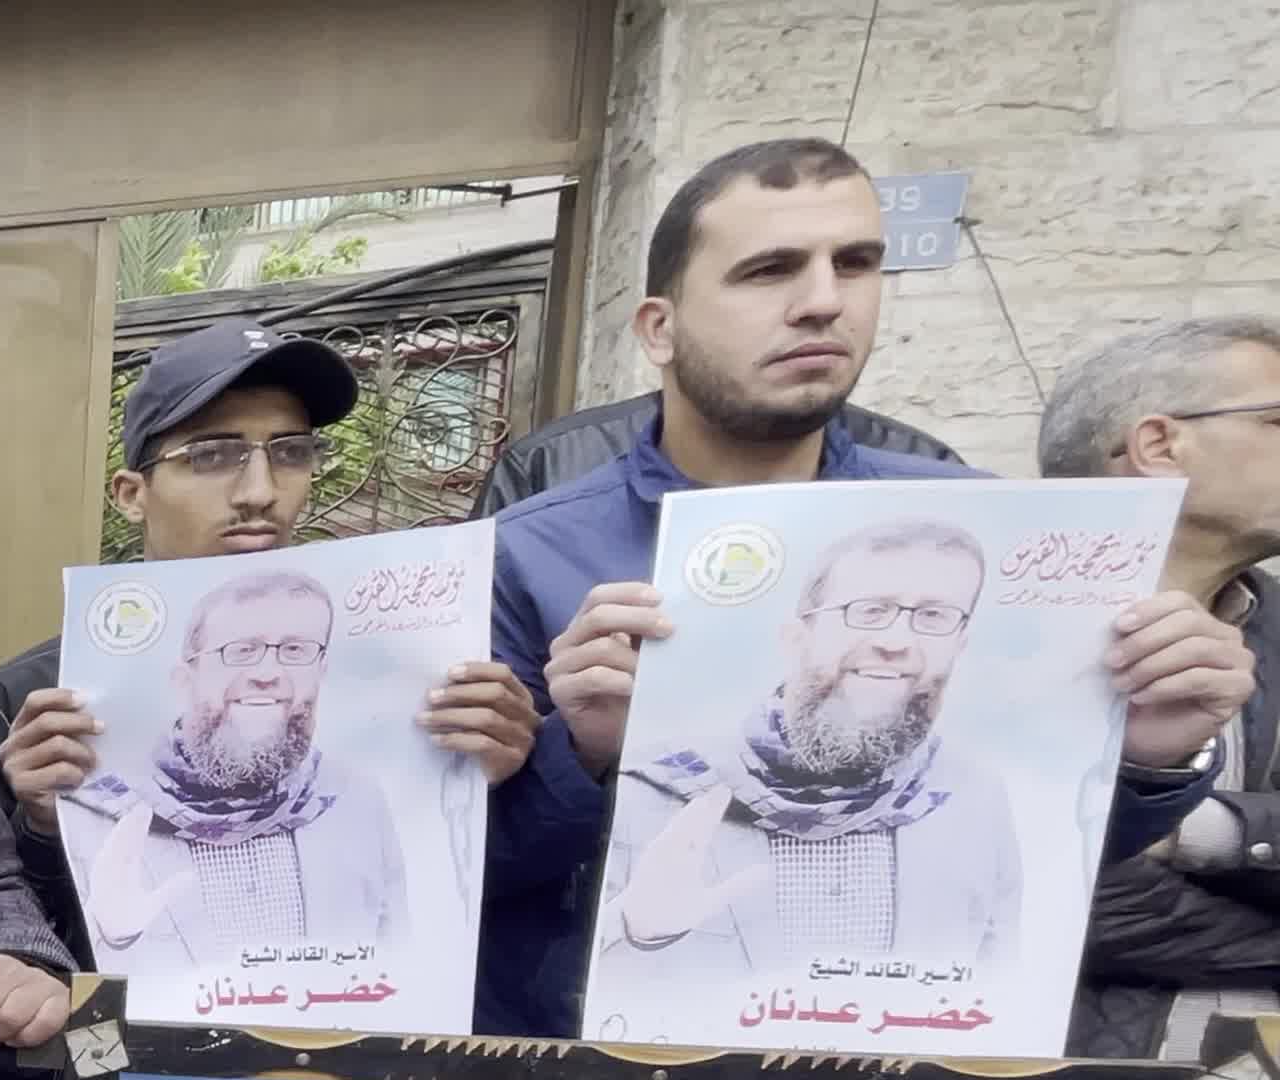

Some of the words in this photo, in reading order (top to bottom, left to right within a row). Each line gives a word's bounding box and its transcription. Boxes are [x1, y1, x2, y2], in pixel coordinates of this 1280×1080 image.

[809, 957, 860, 980] الشيخ
[865, 961, 915, 979] القائد
[196, 976, 289, 1014] عدنان
[296, 973, 399, 1012] خضر
[739, 987, 861, 1028] عدنان
[867, 997, 993, 1034] خضر
